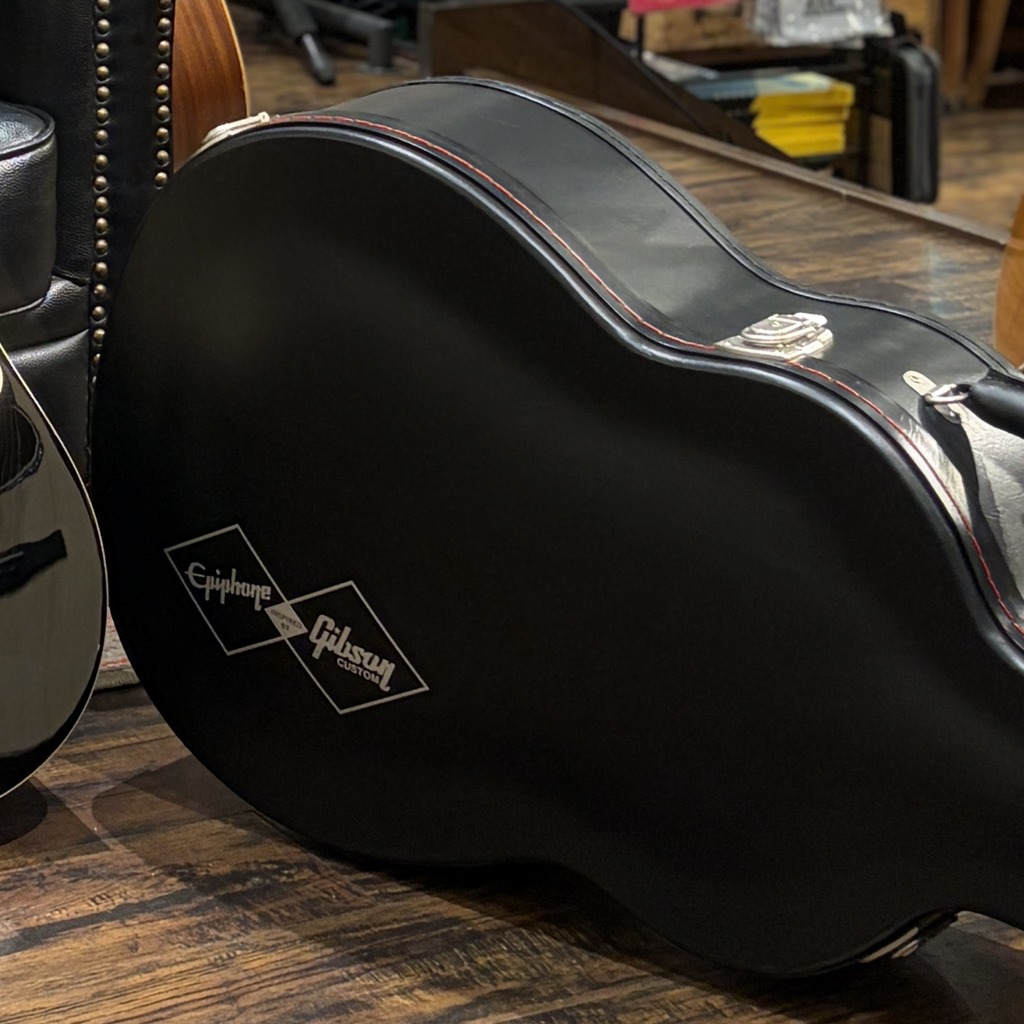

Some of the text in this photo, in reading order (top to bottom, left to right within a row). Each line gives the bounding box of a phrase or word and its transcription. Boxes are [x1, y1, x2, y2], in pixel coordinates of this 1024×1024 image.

[184, 562, 272, 611] Epiphone
[308, 614, 396, 692] Gibson
[336, 657, 381, 684] CUSTOM
